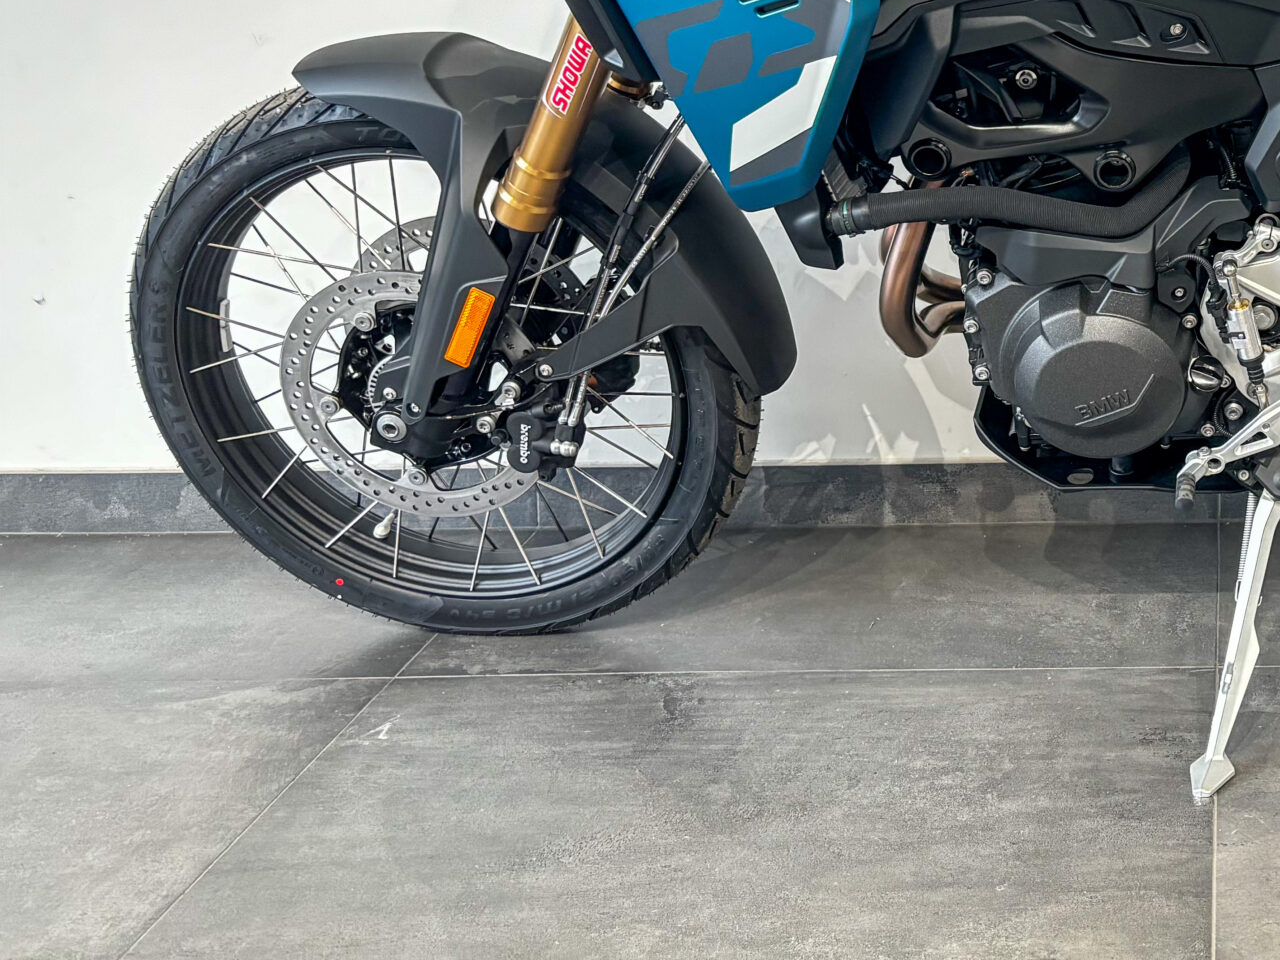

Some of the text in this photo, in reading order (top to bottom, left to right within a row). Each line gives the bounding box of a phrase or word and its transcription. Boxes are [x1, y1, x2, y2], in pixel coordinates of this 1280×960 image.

[551, 33, 593, 115] SHOWA
[149, 302, 218, 478] METZELER
[1074, 389, 1131, 420] BMW
[520, 424, 532, 464] brembo
